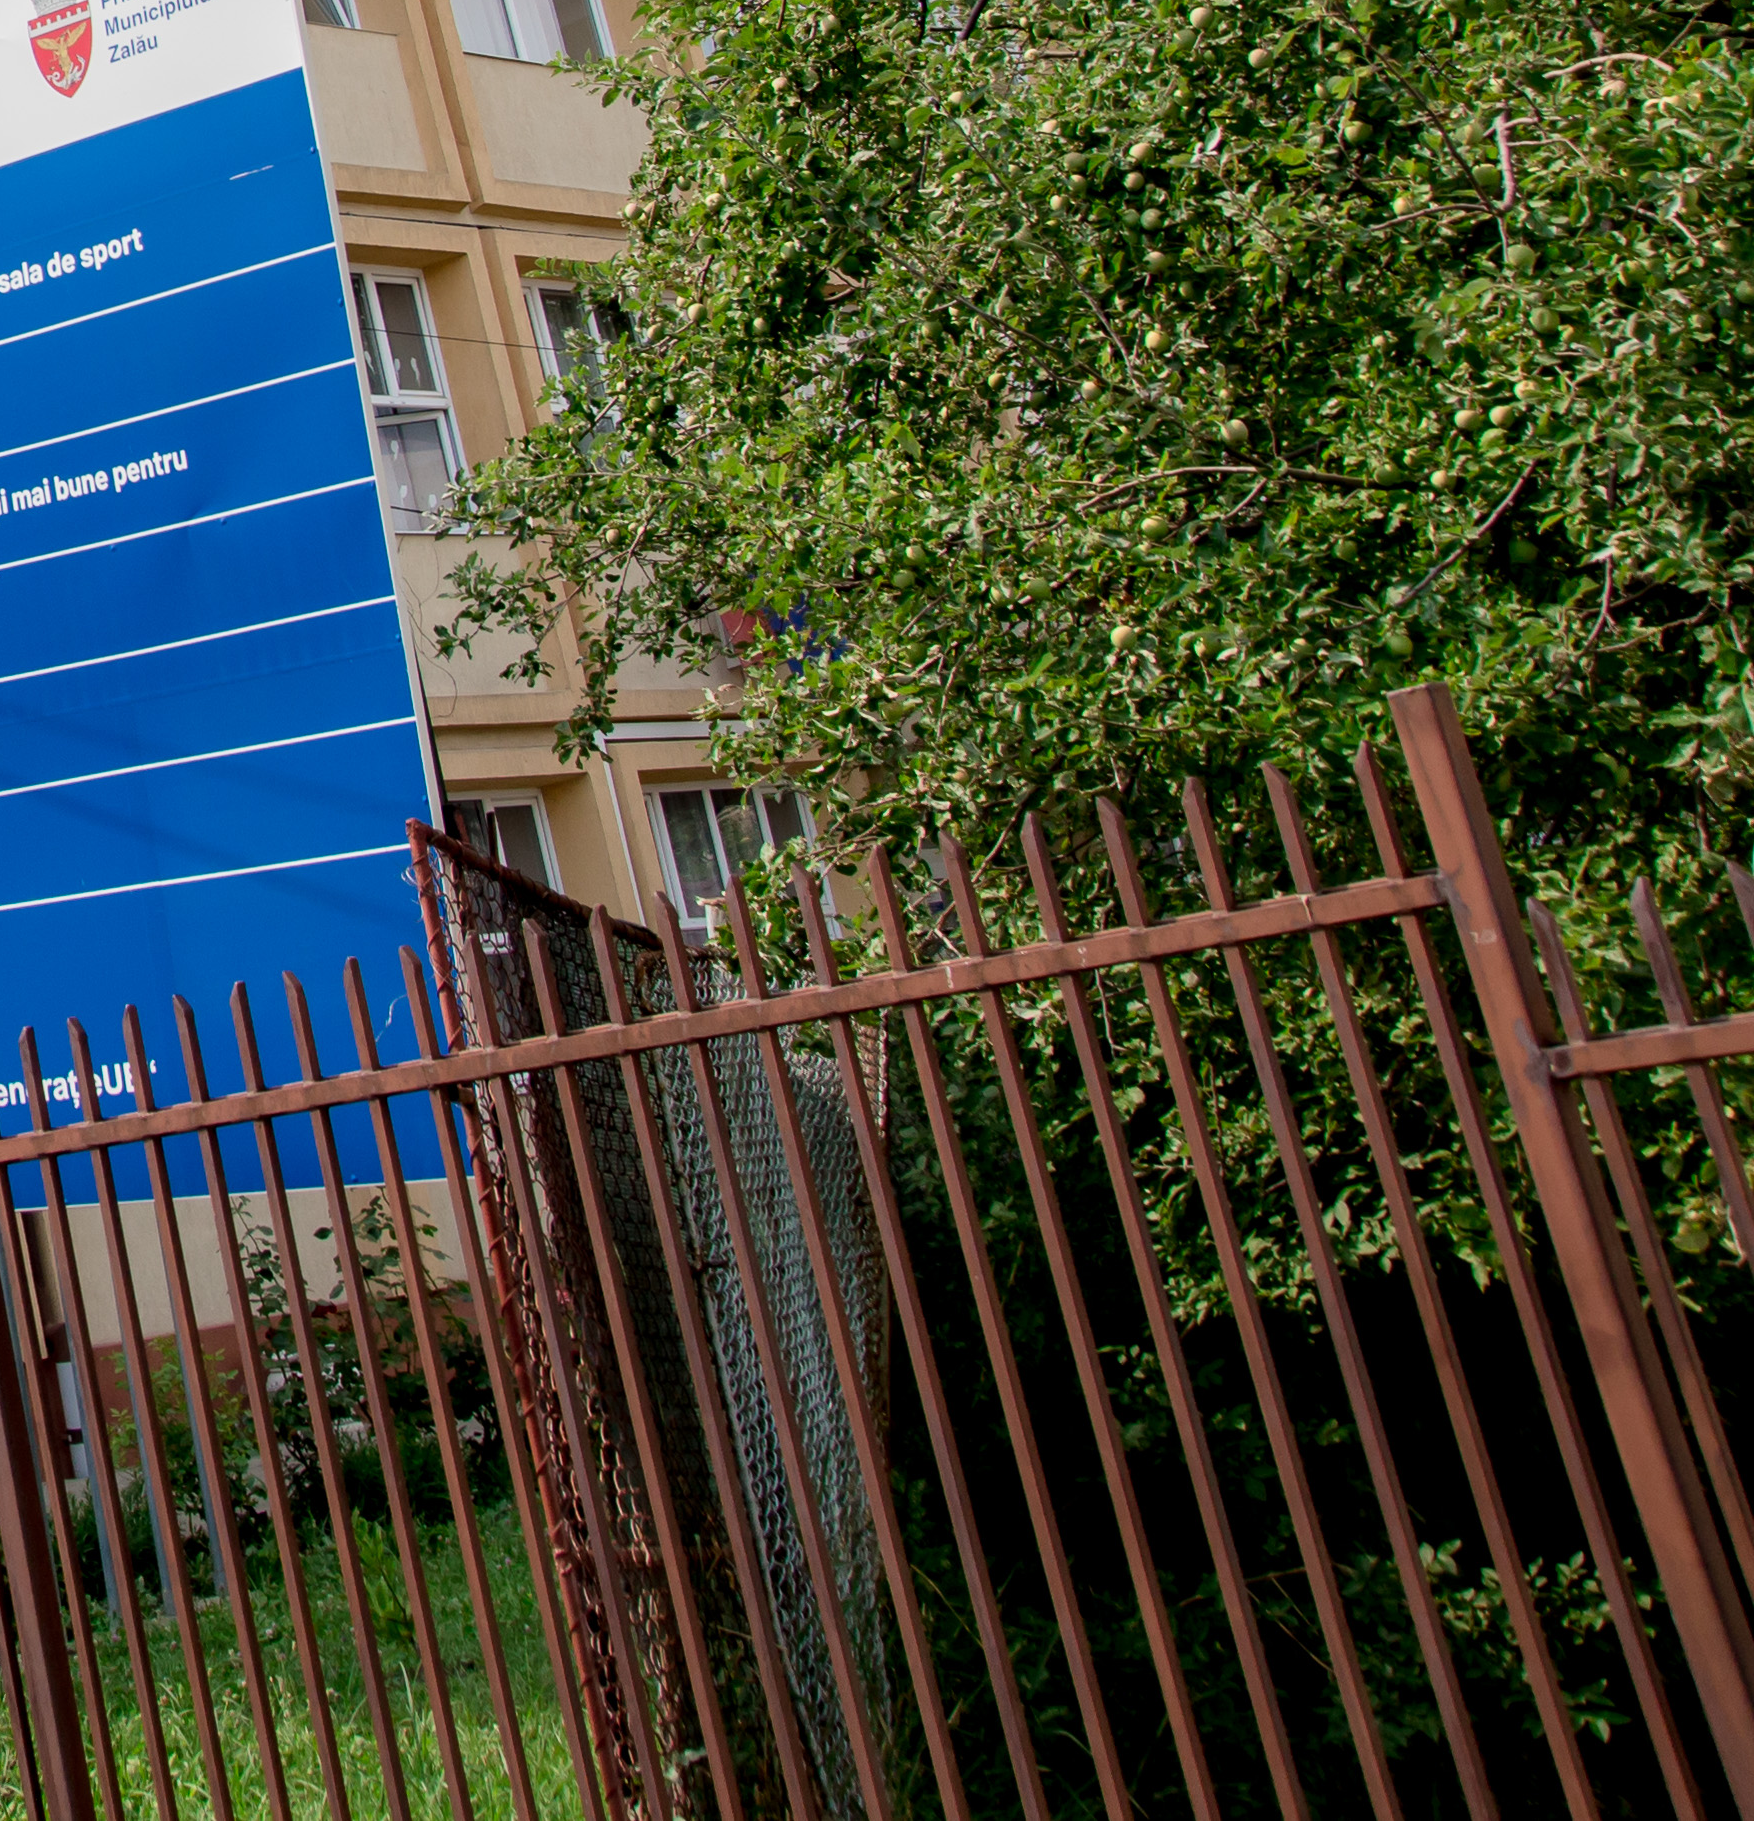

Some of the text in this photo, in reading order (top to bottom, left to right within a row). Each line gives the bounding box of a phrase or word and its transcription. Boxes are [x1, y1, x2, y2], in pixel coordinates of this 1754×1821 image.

[109, 34, 158, 63] Zalău
[47, 252, 75, 278] de
[80, 229, 143, 270] sport
[12, 478, 51, 511] mai
[54, 471, 108, 500] bune
[113, 450, 188, 492] pentru
